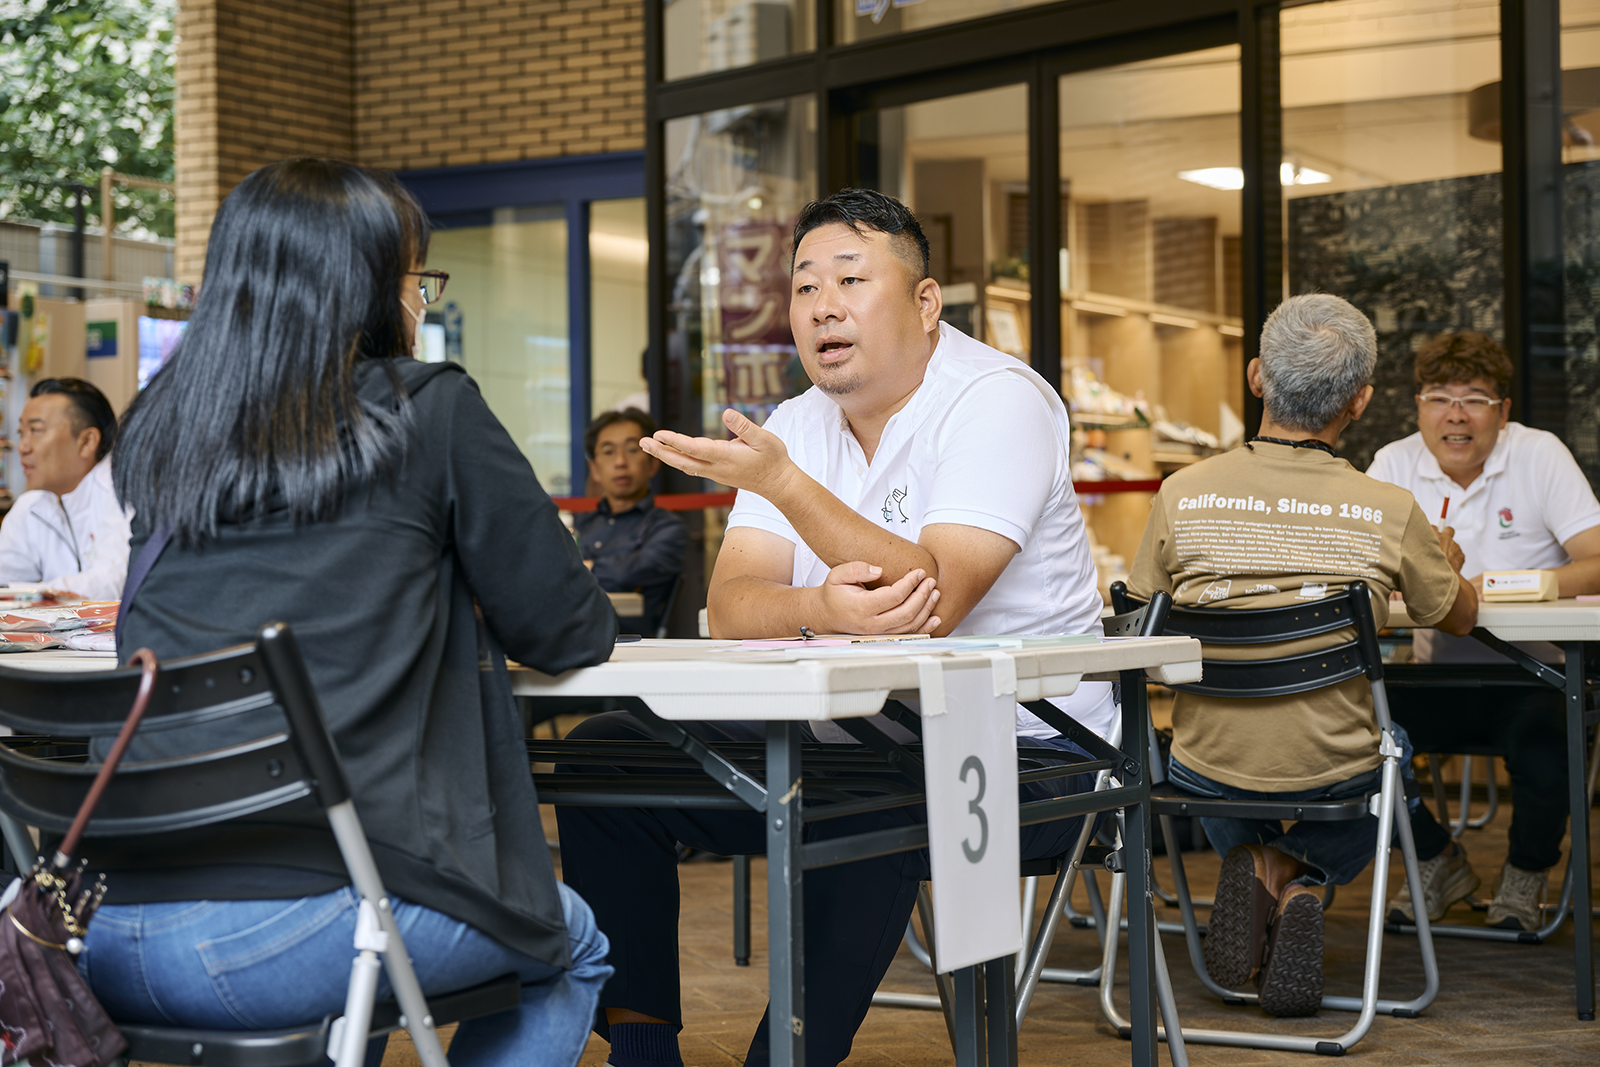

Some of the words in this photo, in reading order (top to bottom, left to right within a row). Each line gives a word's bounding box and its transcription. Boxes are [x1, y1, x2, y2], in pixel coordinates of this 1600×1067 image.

[722, 233, 785, 427] マンホ
[1178, 493, 1271, 515] California,
[1277, 498, 1332, 515] Since
[1339, 503, 1383, 524] 1966
[959, 755, 989, 864] 3
